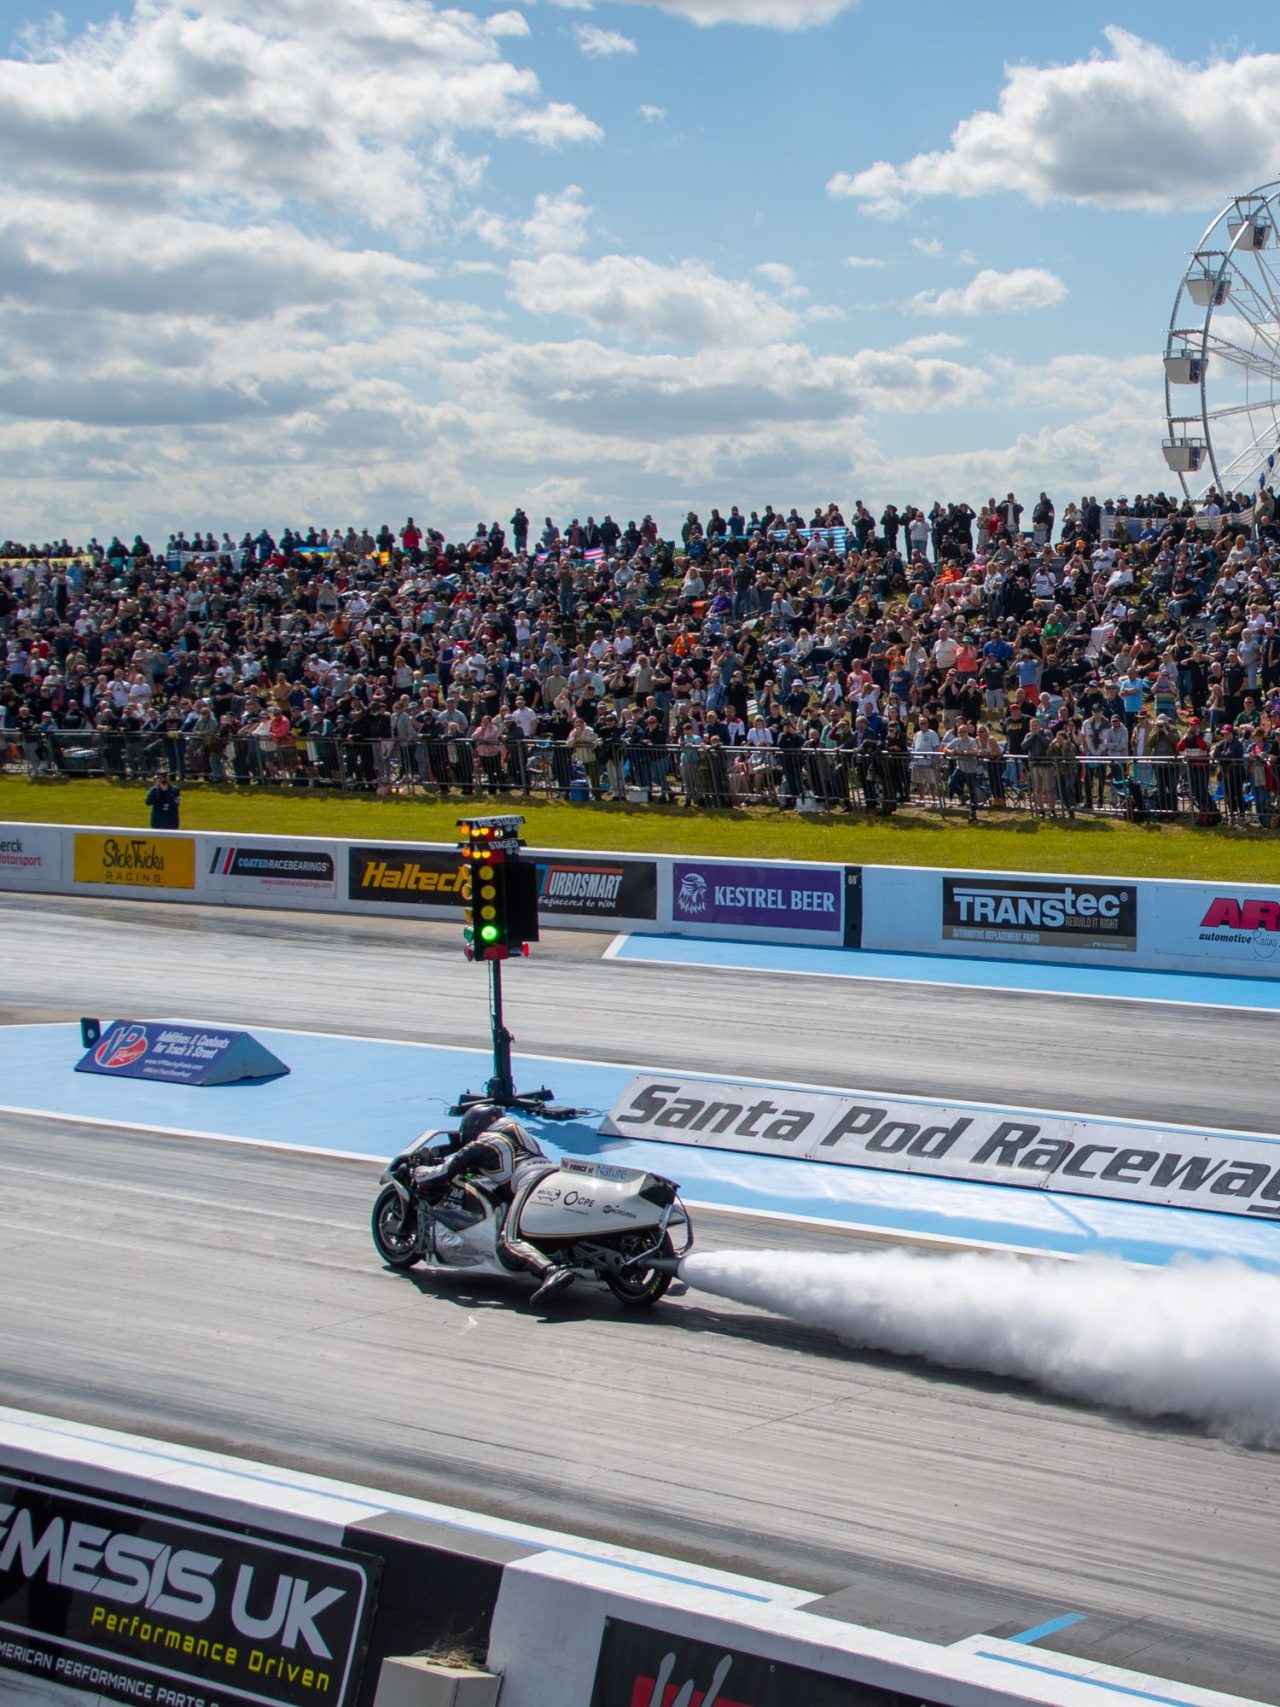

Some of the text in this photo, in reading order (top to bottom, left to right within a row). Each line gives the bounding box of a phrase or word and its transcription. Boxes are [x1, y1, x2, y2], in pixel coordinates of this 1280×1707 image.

[488, 840, 519, 849] STAGED
[0, 855, 41, 867] otorsport
[106, 871, 162, 883] RACING
[536, 864, 623, 899] TURBOSMART
[586, 898, 595, 907] to
[714, 885, 836, 913] KESTREL BEER
[1065, 915, 1119, 930] REBUILD IT RIGHT
[1199, 932, 1252, 944] automotive
[98, 1024, 147, 1066] VP
[617, 1083, 815, 1142] Santa
[820, 1105, 974, 1161] Pod
[596, 1164, 628, 1179] Nature
[231, 1563, 347, 1661] UK
[91, 1605, 331, 1693] Performance Driven
[55, 1657, 154, 1699] PERFORMANCE
